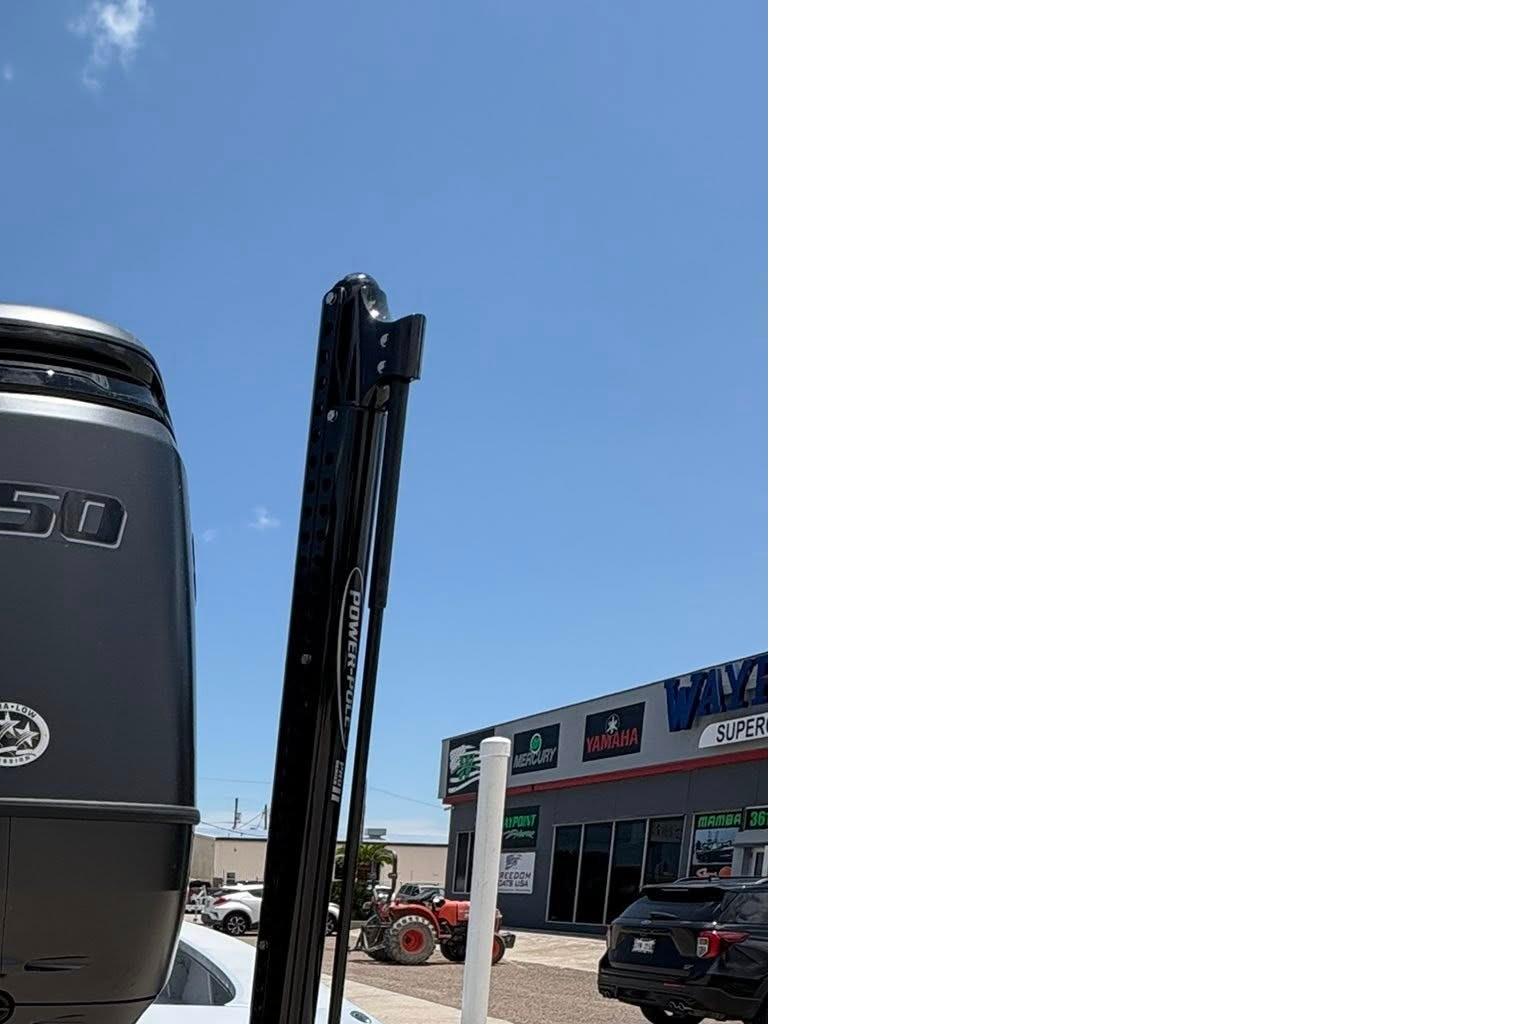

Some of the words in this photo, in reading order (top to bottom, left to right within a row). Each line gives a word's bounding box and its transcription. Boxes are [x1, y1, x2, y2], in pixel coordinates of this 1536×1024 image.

[344, 589, 362, 728] POWER-POLE
[586, 727, 639, 753] YAMAHA
[716, 716, 768, 743] SUPER
[513, 747, 557, 769] MERCURY
[698, 813, 742, 828] MAMBA
